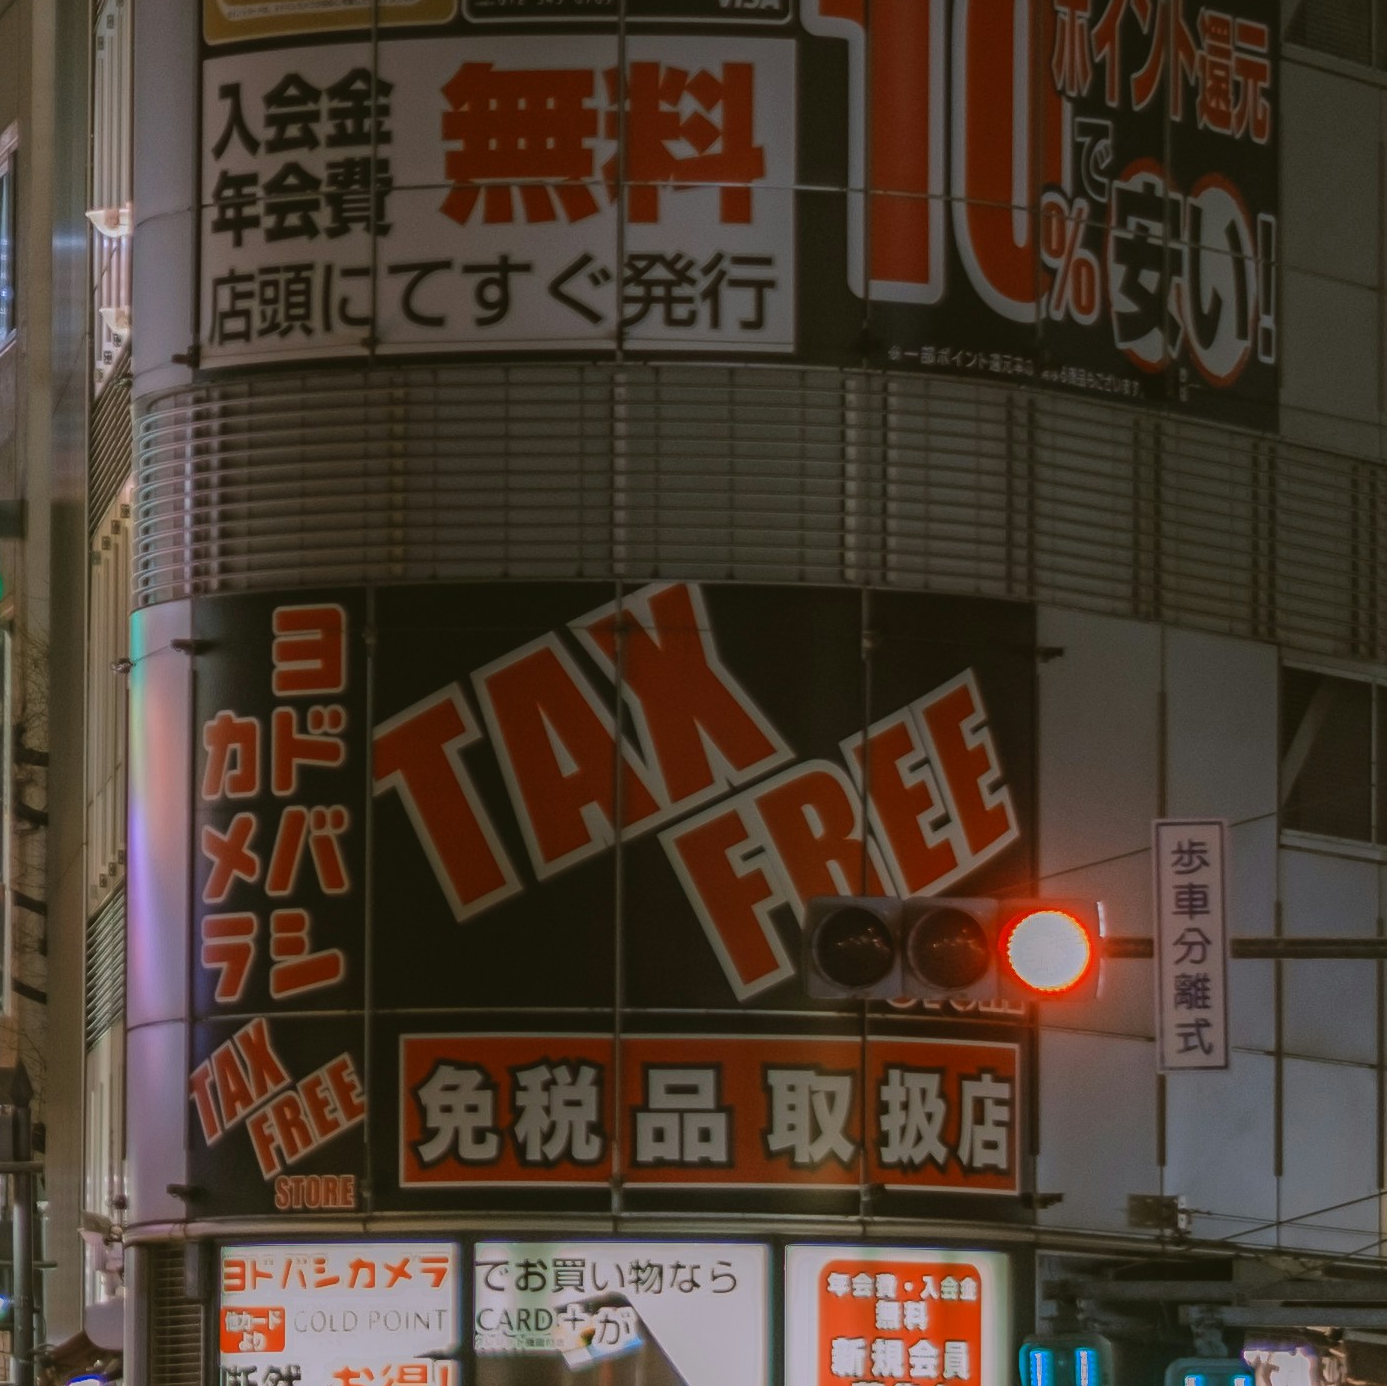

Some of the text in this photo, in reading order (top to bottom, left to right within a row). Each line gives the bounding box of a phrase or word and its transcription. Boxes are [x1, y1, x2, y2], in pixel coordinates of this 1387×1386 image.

[215, 67, 394, 158] 入会金
[441, 60, 766, 226] 無料
[1074, 115, 1114, 204] で
[211, 159, 394, 253] 年会費
[209, 251, 776, 346] 店頭にてすぐ発行
[265, 603, 350, 1000] ヨドバシ
[373, 582, 795, 923] TAX
[201, 710, 261, 1004] カメラ
[657, 668, 1021, 1002] FREE
[1172, 838, 1213, 1056] 歩車分離式
[189, 1018, 291, 1146] TAX
[245, 1052, 368, 1181] FREE
[417, 1063, 1013, 1175] 免税品取扱店
[274, 1174, 356, 1210] STORE
[223, 1255, 738, 1295] ヨドバシカメラ でお買い物なら
[367, 1308, 449, 1332] POINT
